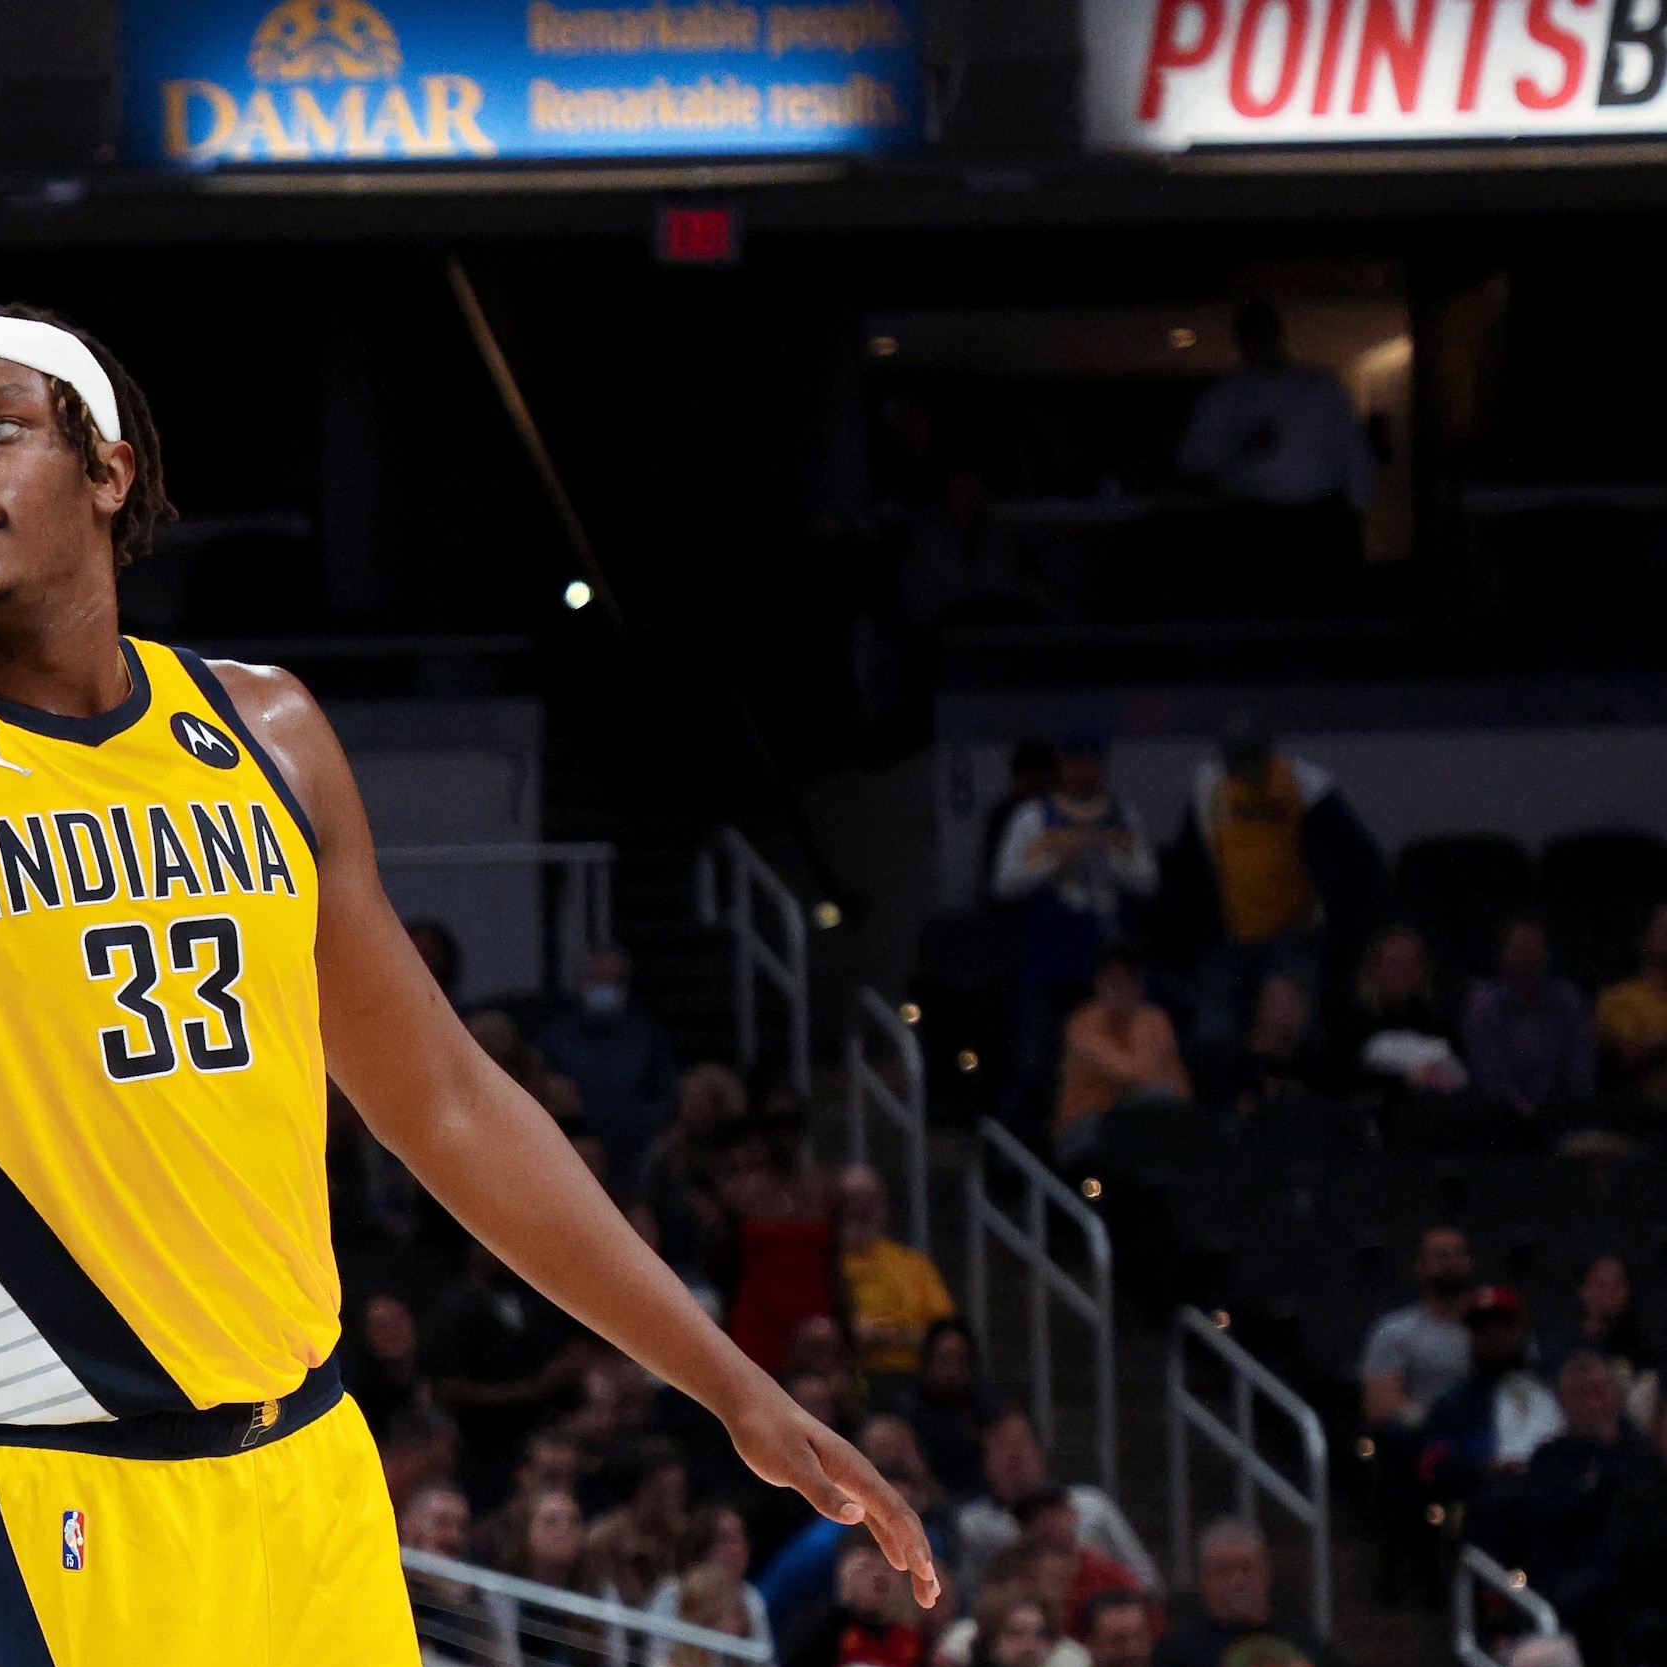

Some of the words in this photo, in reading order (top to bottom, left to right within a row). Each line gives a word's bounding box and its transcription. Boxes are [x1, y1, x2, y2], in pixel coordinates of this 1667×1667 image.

[162, 72, 497, 162] DAMAR
[527, 76, 760, 131] Remarkable
[81, 912, 255, 1084] 33
